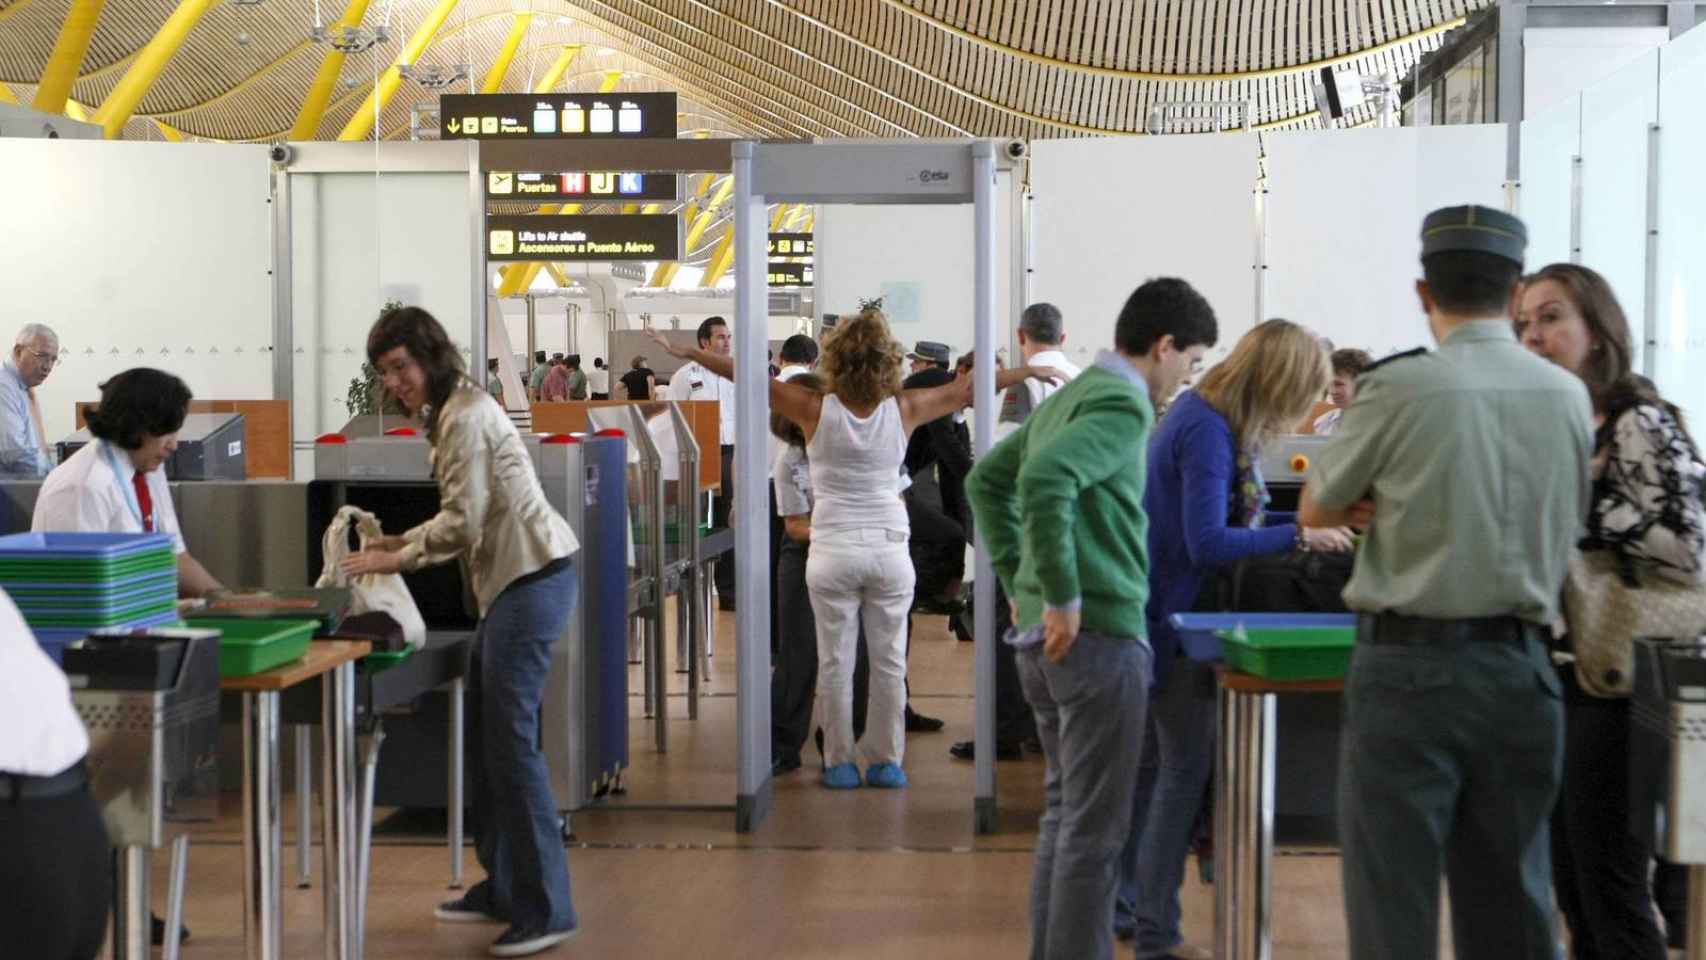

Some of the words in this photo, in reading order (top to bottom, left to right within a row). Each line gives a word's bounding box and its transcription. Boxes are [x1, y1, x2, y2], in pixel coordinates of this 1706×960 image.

[518, 182, 556, 193] Puertas
[537, 232, 546, 241] to
[547, 231, 559, 241] Air
[519, 243, 575, 253] Ascensores
[578, 244, 585, 253] a
[587, 242, 622, 253] Puente
[624, 241, 655, 253] Aéreo
